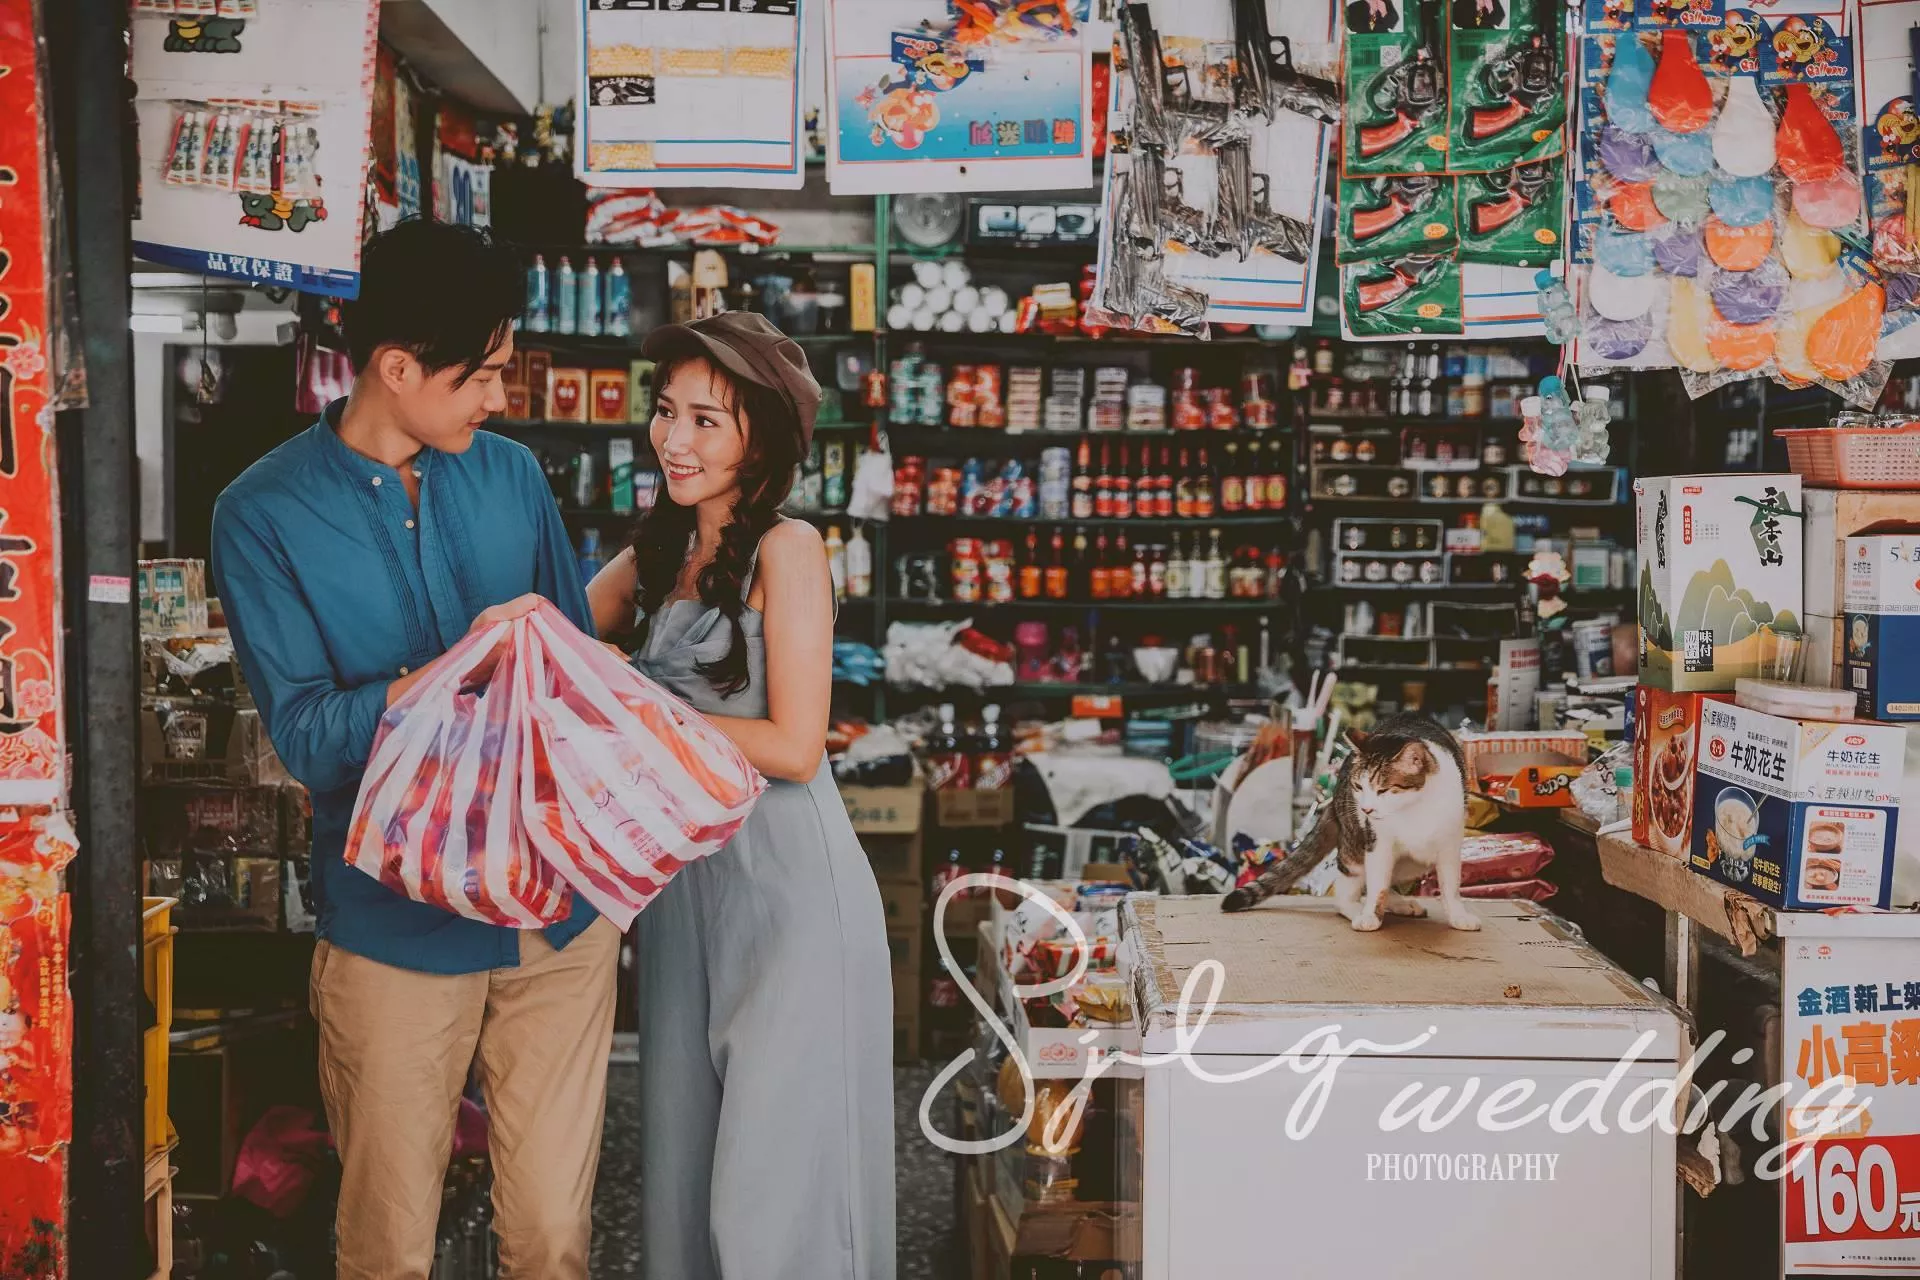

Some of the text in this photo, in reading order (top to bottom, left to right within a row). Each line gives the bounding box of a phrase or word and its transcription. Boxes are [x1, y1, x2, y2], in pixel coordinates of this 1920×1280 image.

[1680, 10, 1722, 25] Balloons
[1806, 63, 1848, 78] Balloons
[207, 252, 294, 283] 品質保證
[1700, 631, 1713, 657] 味付
[1731, 741, 1787, 782] 牛奶花生
[1827, 749, 1880, 765] 牛奶花生
[1797, 981, 1920, 1016] 金酒新上架
